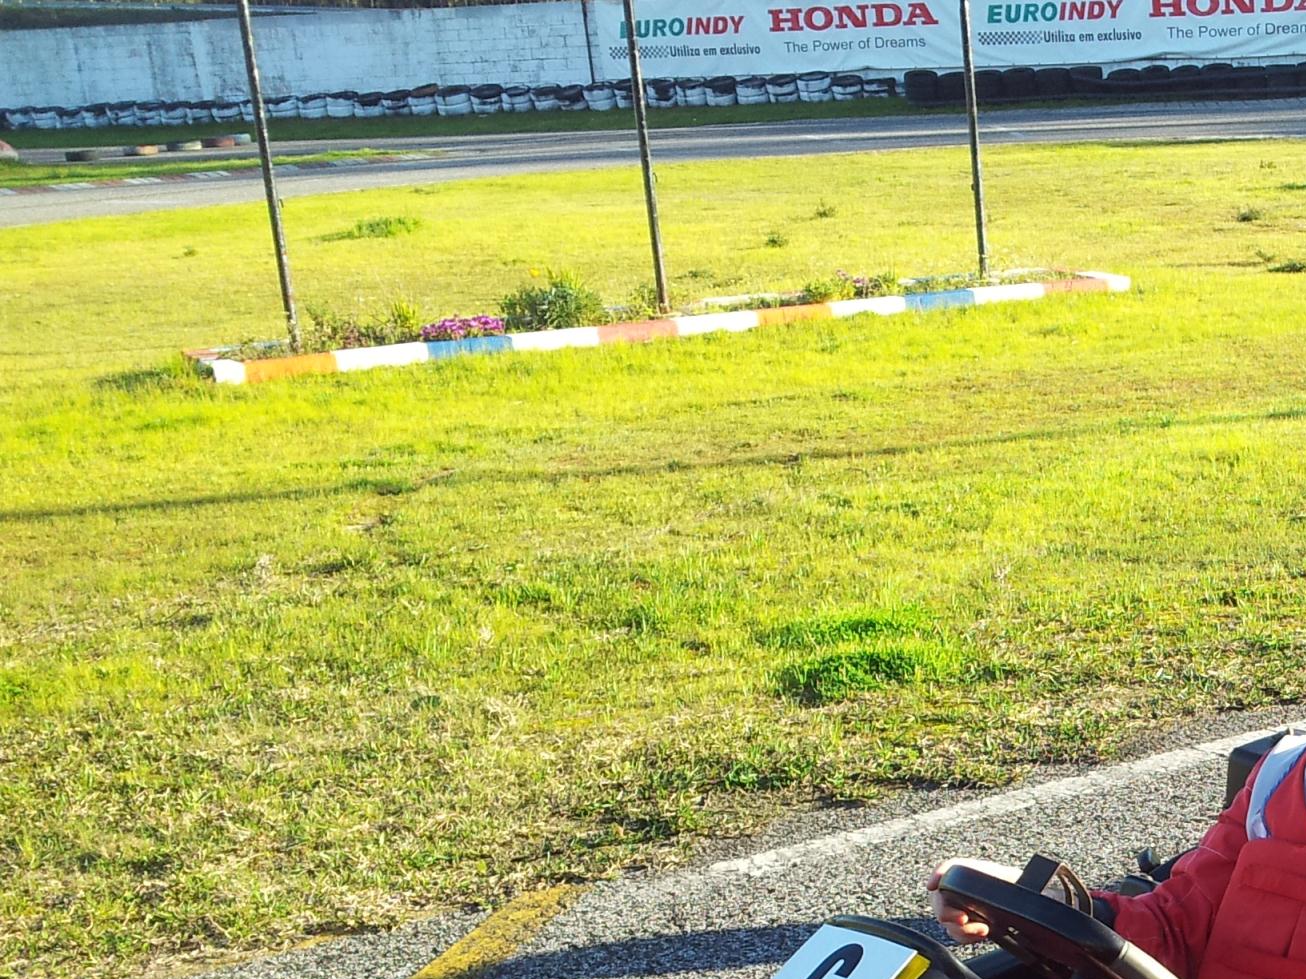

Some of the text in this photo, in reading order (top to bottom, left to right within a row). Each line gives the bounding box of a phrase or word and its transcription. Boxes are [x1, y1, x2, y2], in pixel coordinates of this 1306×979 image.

[768, 2, 939, 32] HONDA
[987, 0, 1124, 24] EUROINDY
[1043, 28, 1143, 43] Utiliza em exclusivo
[1167, 26, 1194, 39] The
[1198, 25, 1243, 38] Power
[1247, 23, 1261, 36] of
[669, 43, 761, 57] Utiliza em exclusivo
[784, 36, 927, 53] The Power of Dreams
